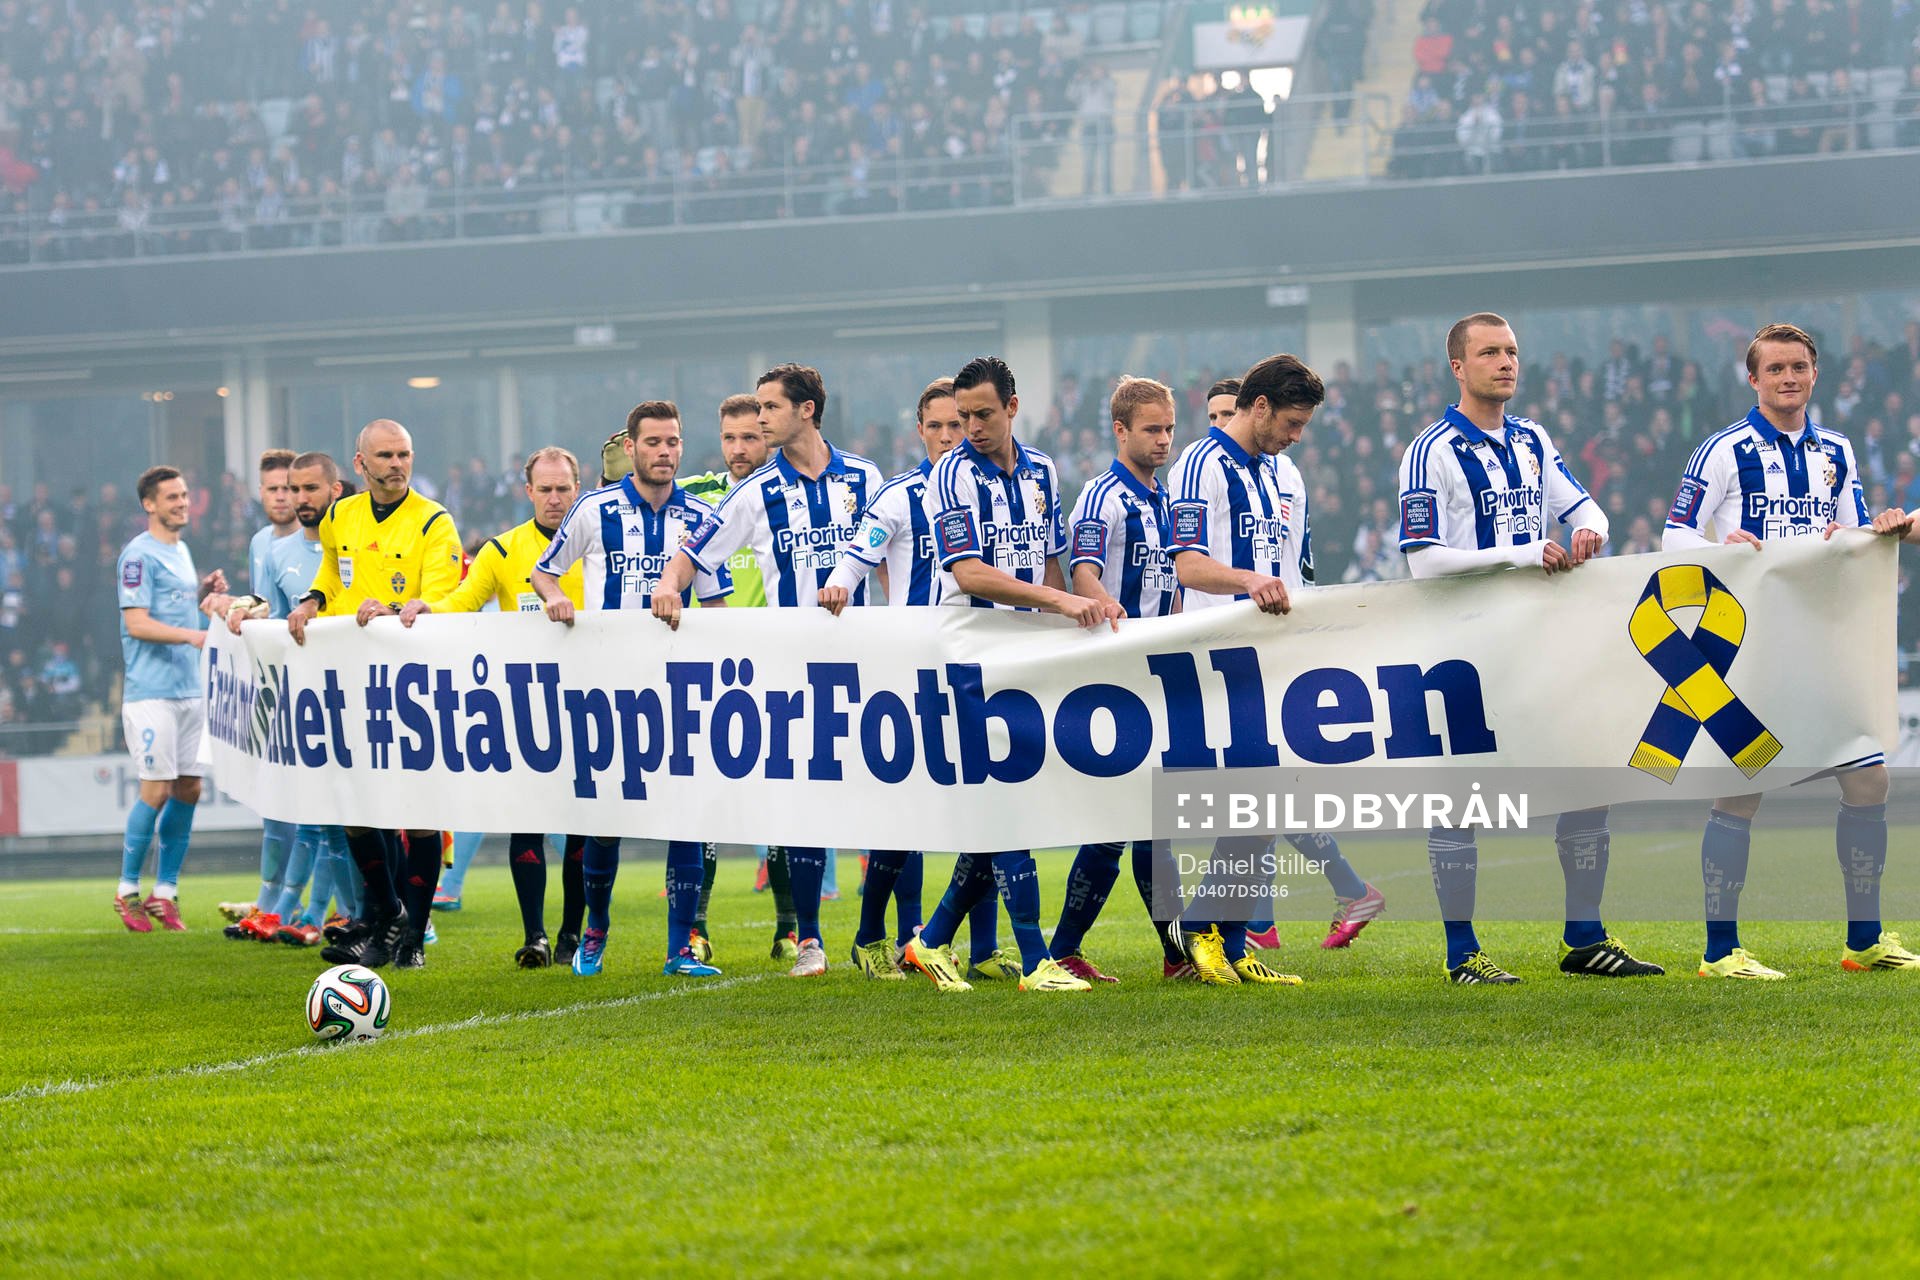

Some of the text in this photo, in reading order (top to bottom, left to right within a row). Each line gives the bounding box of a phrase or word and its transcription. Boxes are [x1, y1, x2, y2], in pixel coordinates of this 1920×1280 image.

[1752, 494, 1838, 519] Prioritet
[793, 550, 847, 570] Finan
[995, 547, 1045, 567] Finans
[521, 604, 540, 612] FIFA
[364, 647, 1498, 800] #StåUppFörFotbollen
[142, 727, 155, 753] 9
